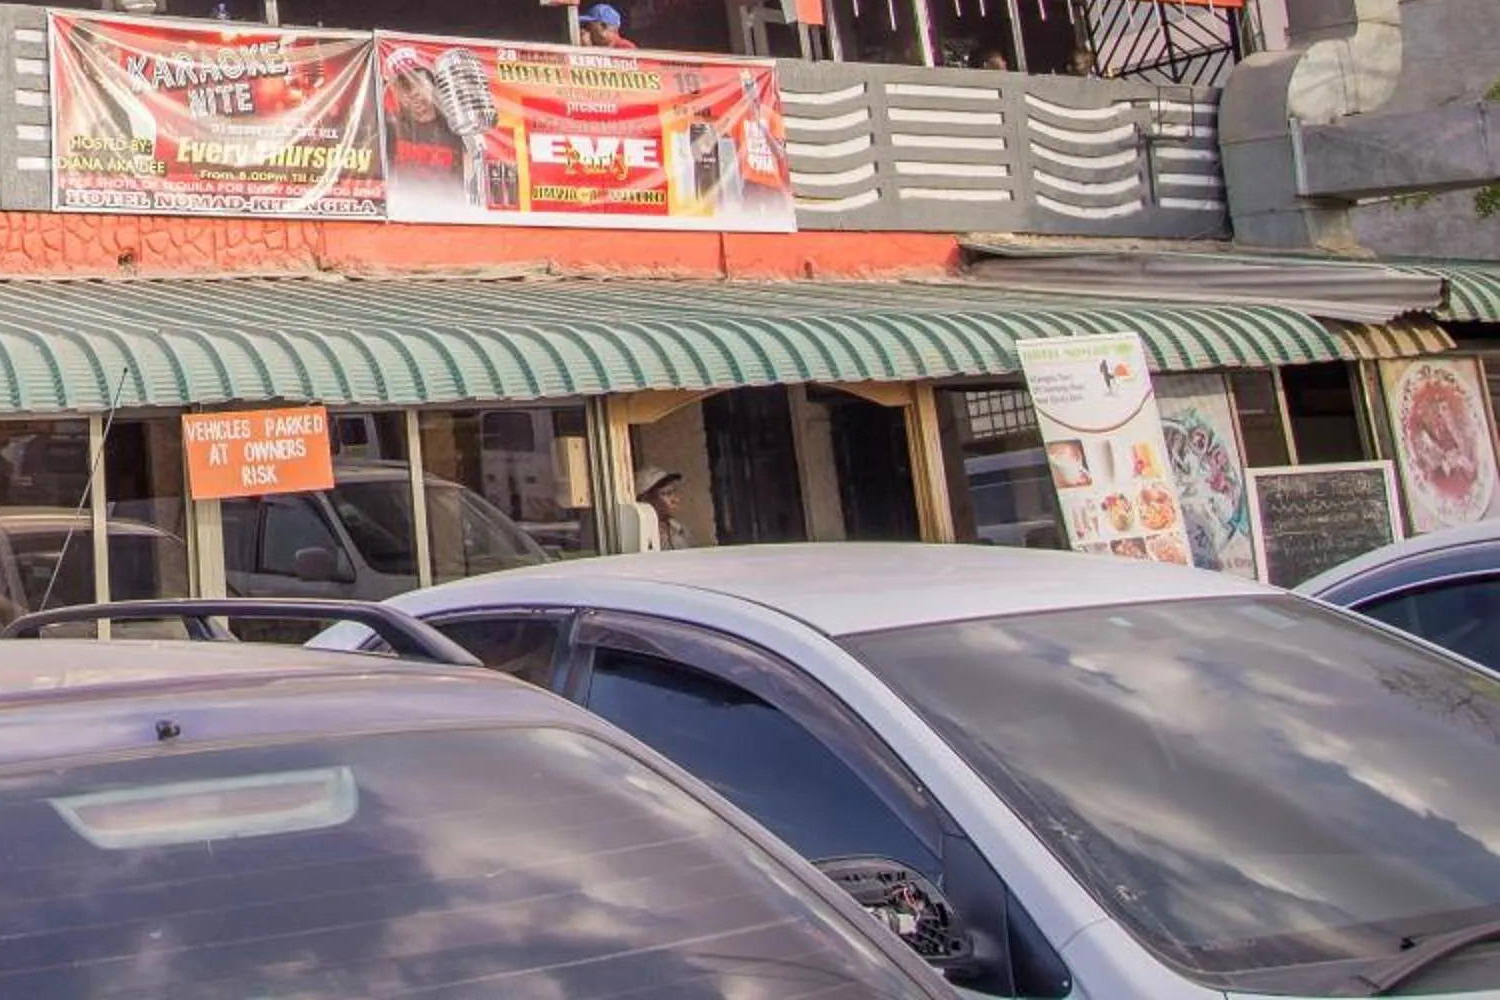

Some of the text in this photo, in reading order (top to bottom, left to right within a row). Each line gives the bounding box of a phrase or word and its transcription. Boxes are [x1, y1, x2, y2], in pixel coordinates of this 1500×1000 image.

[569, 68, 662, 91] NOMADS
[70, 136, 129, 151] HOSTED
[176, 137, 248, 167] Every
[255, 139, 373, 172] Thursday
[57, 156, 104, 171] DIANA
[201, 169, 233, 181] From
[218, 183, 243, 194] FOR
[67, 190, 377, 215] HOTEL NOMAD-KITNGELA
[186, 413, 324, 441] VEHICLES PARKED
[209, 438, 307, 466] AT OWNERS
[241, 464, 278, 487] RISK
